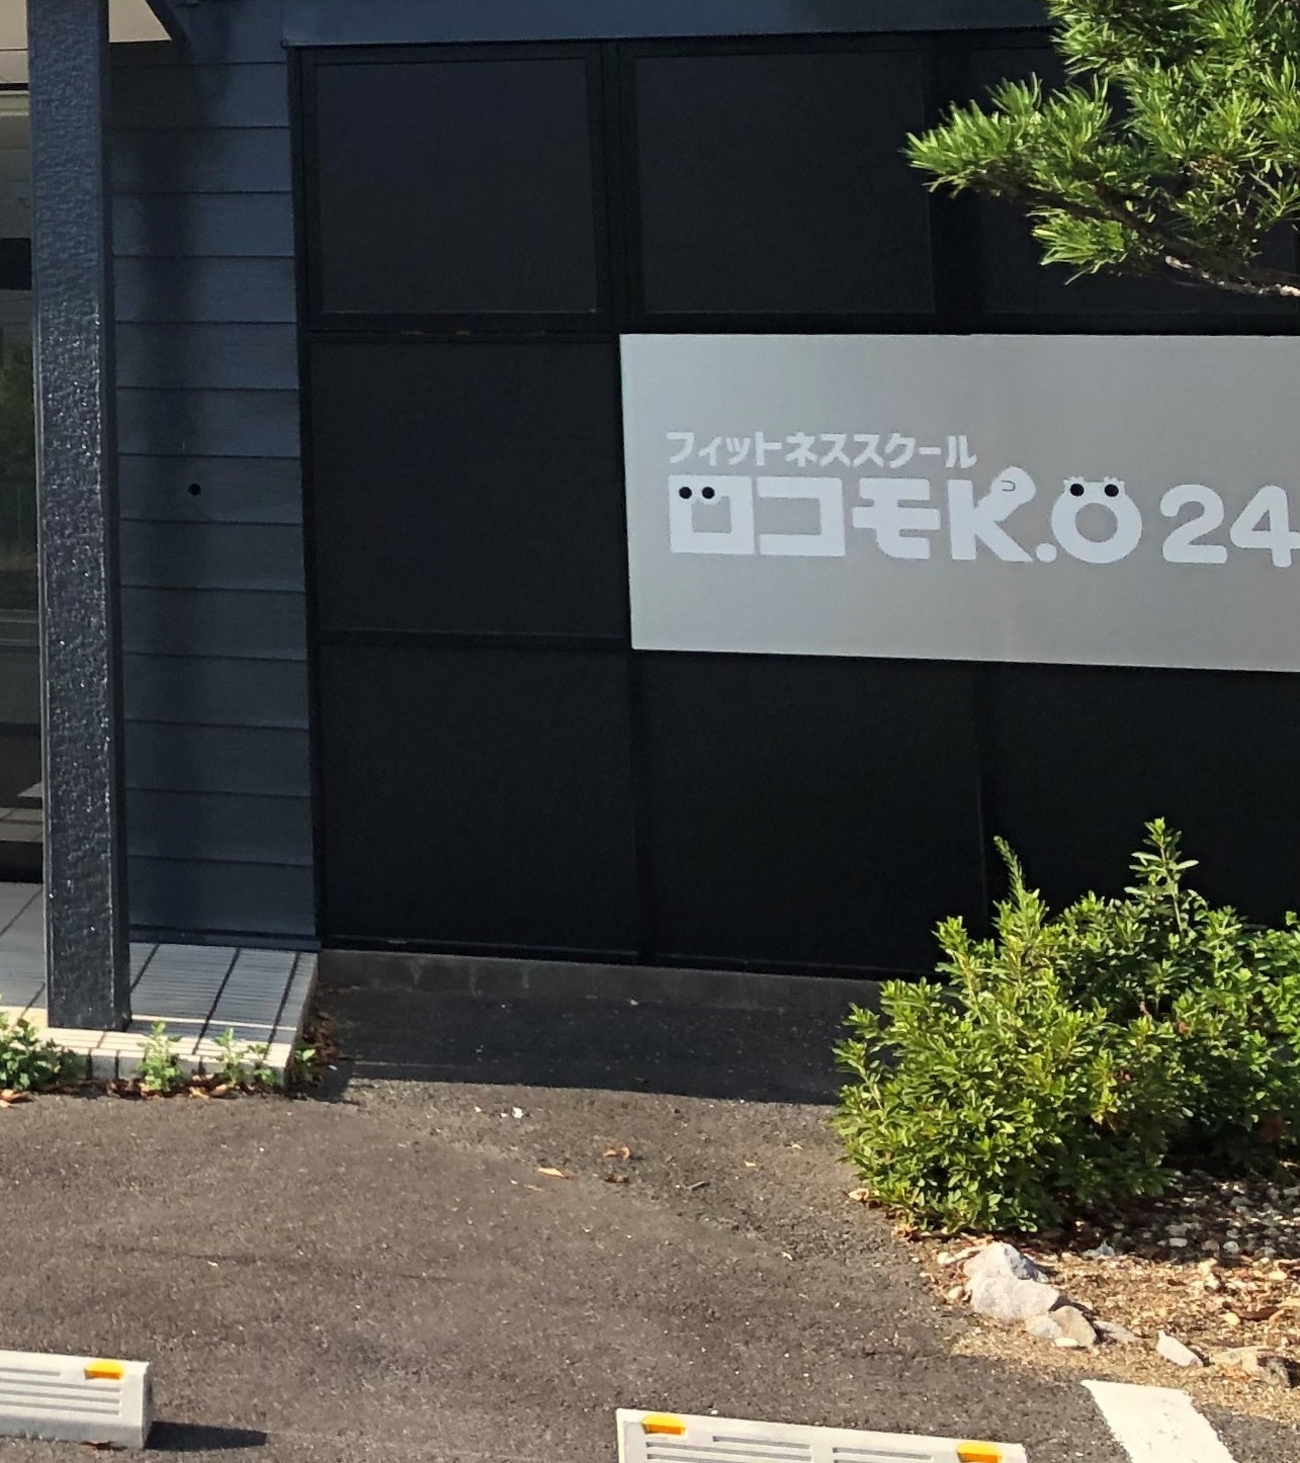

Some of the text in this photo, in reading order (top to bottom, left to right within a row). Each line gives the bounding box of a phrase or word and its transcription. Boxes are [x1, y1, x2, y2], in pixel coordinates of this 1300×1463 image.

[665, 431, 978, 471] フィットネススクール
